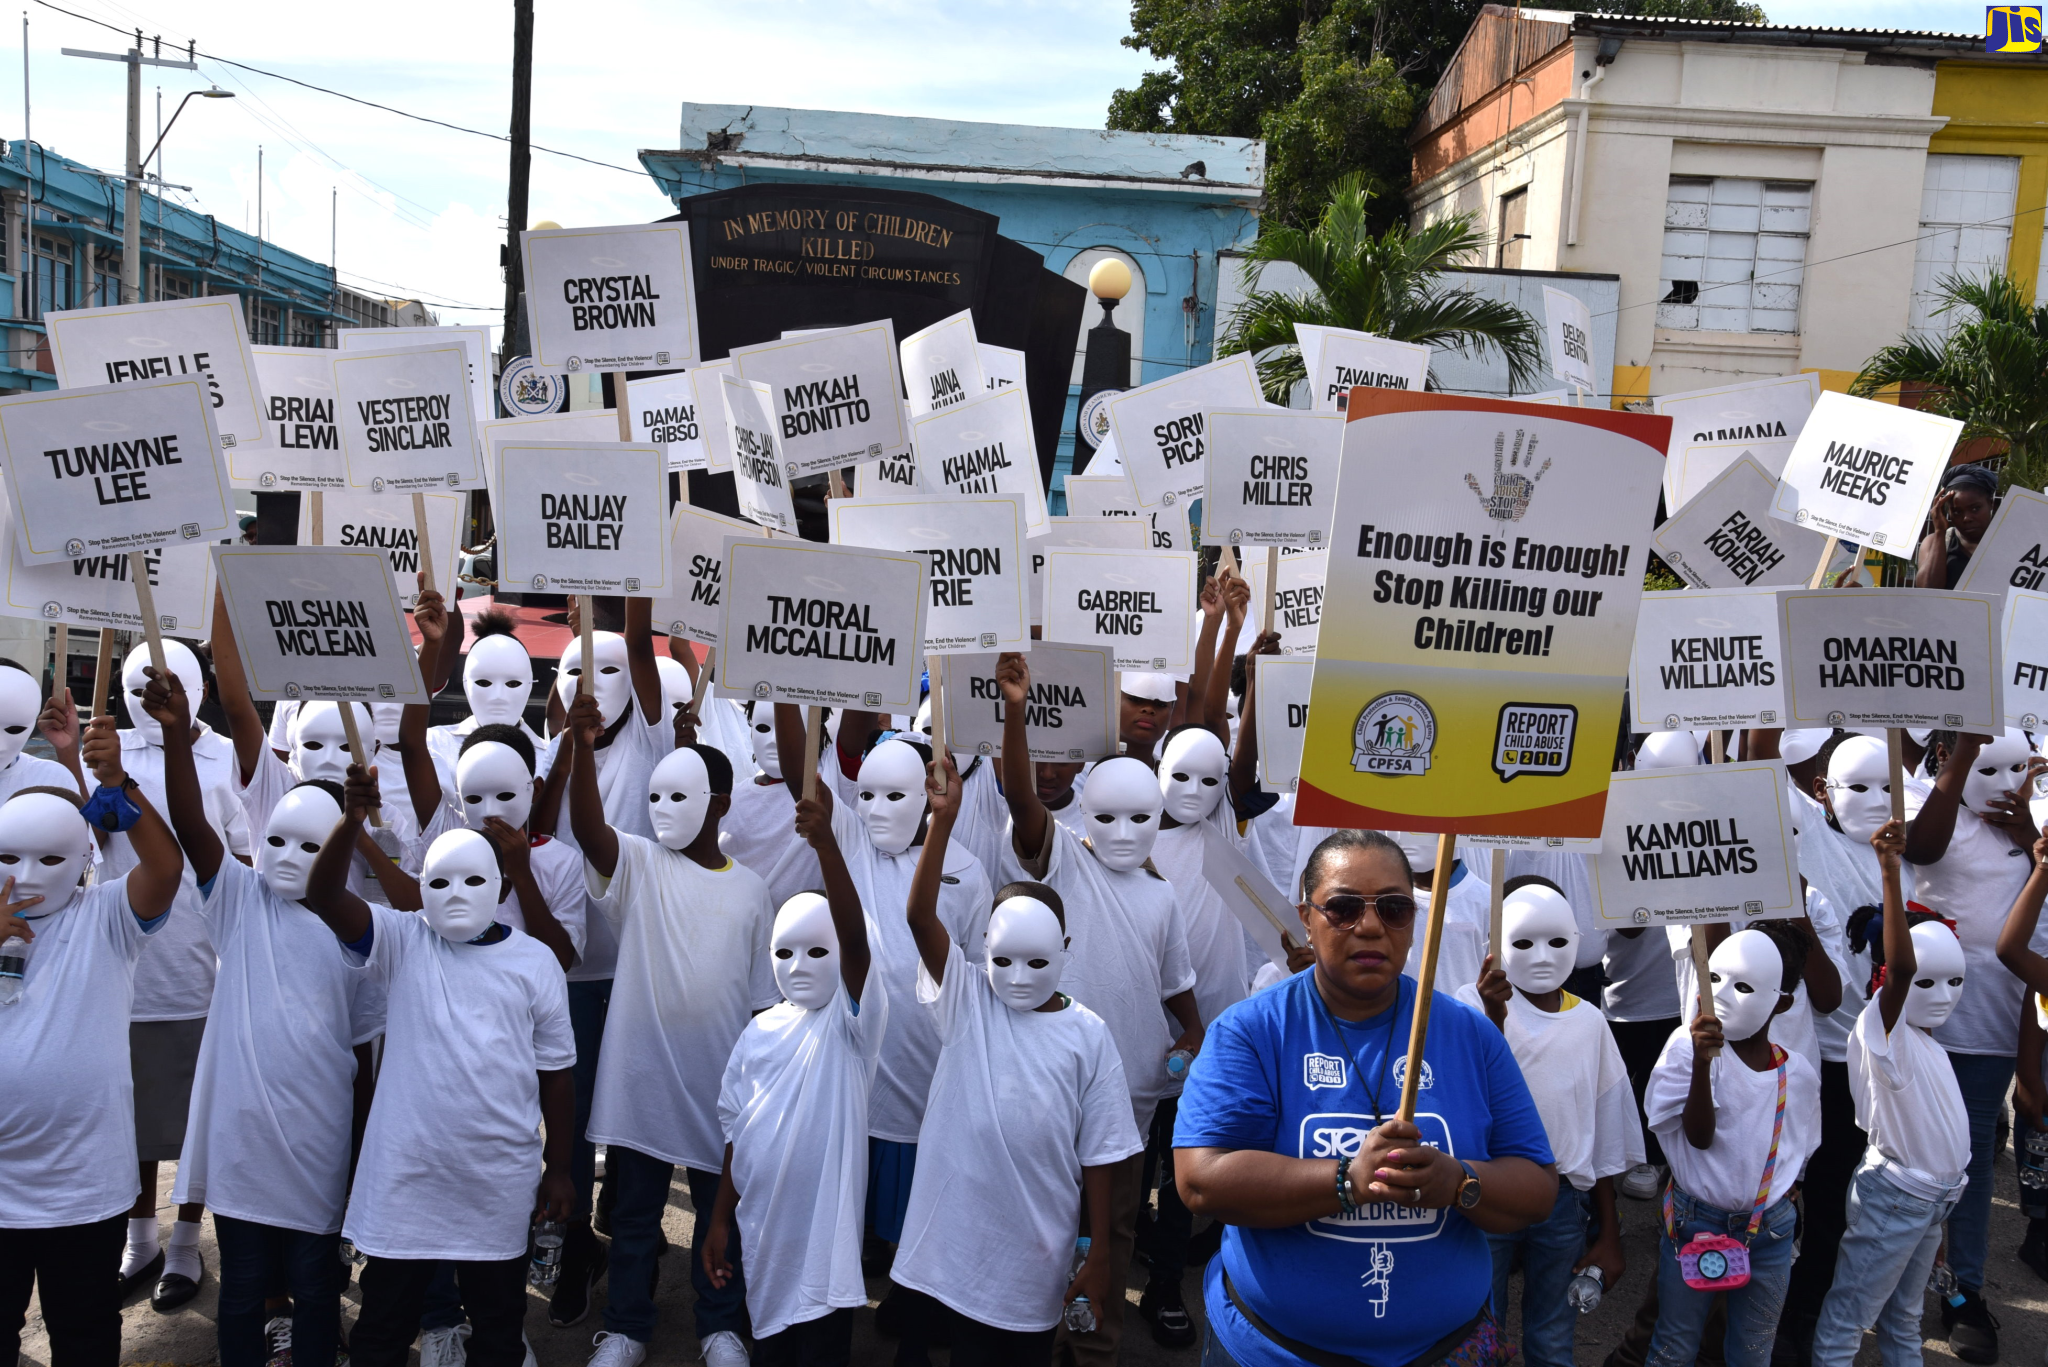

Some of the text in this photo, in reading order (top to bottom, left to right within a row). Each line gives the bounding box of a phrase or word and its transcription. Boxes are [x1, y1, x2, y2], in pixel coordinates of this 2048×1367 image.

[723, 209, 954, 249] IN MEMORY OF CHILDREN
[801, 236, 875, 261] KILLED
[711, 255, 748, 271] UNDER
[806, 262, 856, 278] VIOLENT
[861, 265, 961, 285] CIRCUMSTANCES
[563, 274, 660, 304] CRYSTAL
[572, 301, 656, 331] BROWN
[783, 373, 860, 412] MYKAH
[930, 368, 961, 400] JAINA
[263, 395, 334, 424] BRIA
[357, 394, 451, 426] VESTEROY
[781, 398, 871, 439] BONITTO
[366, 422, 452, 452] SINCLAIR
[651, 422, 700, 443] GIBSO
[44, 434, 183, 480] TUWAYNE
[736, 451, 783, 490] THOMPSON
[942, 441, 1012, 485] KHAMAL
[1249, 454, 1309, 481] CHRIS
[1822, 440, 1914, 485] MAURICE
[879, 459, 916, 486] MAI
[1819, 466, 1891, 506] MEEKS
[94, 470, 151, 506] LEE
[1242, 480, 1313, 507] MILLER
[541, 493, 628, 522] DANJAY
[88, 528, 176, 548] Stop the Silence, End the Violence!
[101, 541, 135, 551] Remembering
[146, 537, 166, 545] Children
[340, 524, 419, 551] SANJAY
[547, 522, 624, 551] BAILEY
[1721, 509, 1786, 572] FARIAH
[906, 547, 1001, 577] RNON
[1357, 524, 1630, 579] Enough is Enough!
[1703, 527, 1765, 586] KOHEN
[73, 553, 161, 586] WHIE
[688, 554, 722, 583] SH
[929, 578, 973, 607] RIE
[1077, 589, 1163, 613] GABRIEL
[1373, 569, 1603, 618] Stop Killing our
[265, 599, 370, 628] DILSHAN
[767, 595, 879, 633] TMORAL
[1095, 612, 1144, 636] KING
[275, 629, 377, 657] MCLEAN
[746, 624, 896, 666] MCCALLUM
[1413, 616, 1554, 657] Children!
[1671, 635, 1763, 663] KENUTE
[1823, 636, 1957, 665] OMARIAN
[1660, 661, 1776, 690] WILLIAMS
[1819, 663, 1965, 691] HANIFORD
[775, 685, 788, 694] Stop
[788, 686, 796, 694] the
[797, 687, 816, 696] Silence,
[817, 689, 827, 697] End
[837, 691, 859, 699] Violence!
[786, 693, 818, 702] Remembering
[970, 676, 1087, 708] ROANNA
[994, 702, 1063, 728] LWIS
[1356, 720, 1366, 736] Child
[1362, 697, 1388, 721] Protection
[1394, 695, 1413, 705] Family
[1413, 701, 1430, 720] Services
[1425, 720, 1433, 740] Agency
[1506, 711, 1569, 735] REPORT
[1849, 713, 1862, 721] Stop
[1504, 734, 1565, 750] CHILD ABUSE
[1367, 757, 1412, 771] CPFSA
[1626, 817, 1749, 853] KAMOILL
[1621, 846, 1758, 882] WILLIAMS
[1654, 909, 1665, 917] Stop
[1675, 907, 1695, 915] Silence,
[1717, 905, 1739, 913] Violence!
[1666, 914, 1698, 922] Remembering
[1309, 1057, 1339, 1071] REPORT
[1324, 1069, 1341, 1077] ABUSE
[1313, 1127, 1371, 1158] STO
